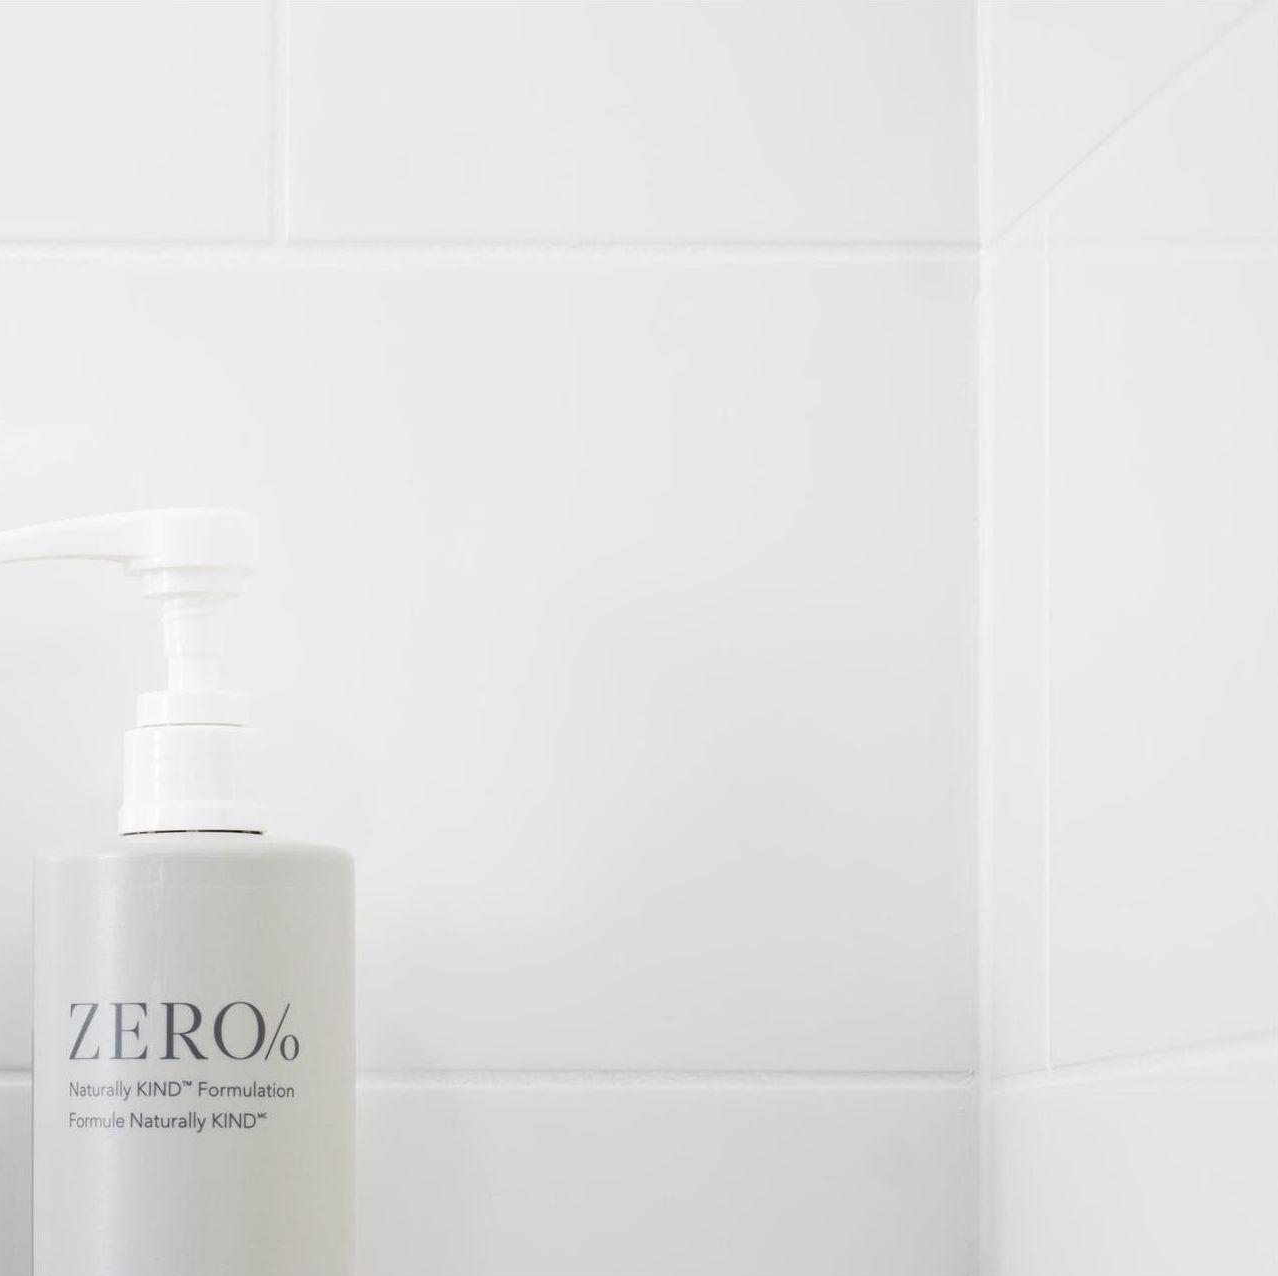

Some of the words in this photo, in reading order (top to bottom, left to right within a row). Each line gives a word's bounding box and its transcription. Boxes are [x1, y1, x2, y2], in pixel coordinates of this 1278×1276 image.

[69, 1001, 300, 1061] ZERO%
[69, 1082, 131, 1101] Naturally
[198, 1082, 295, 1098] Formulation
[69, 1112, 125, 1128] Formule
[130, 1112, 207, 1133] Naturally
